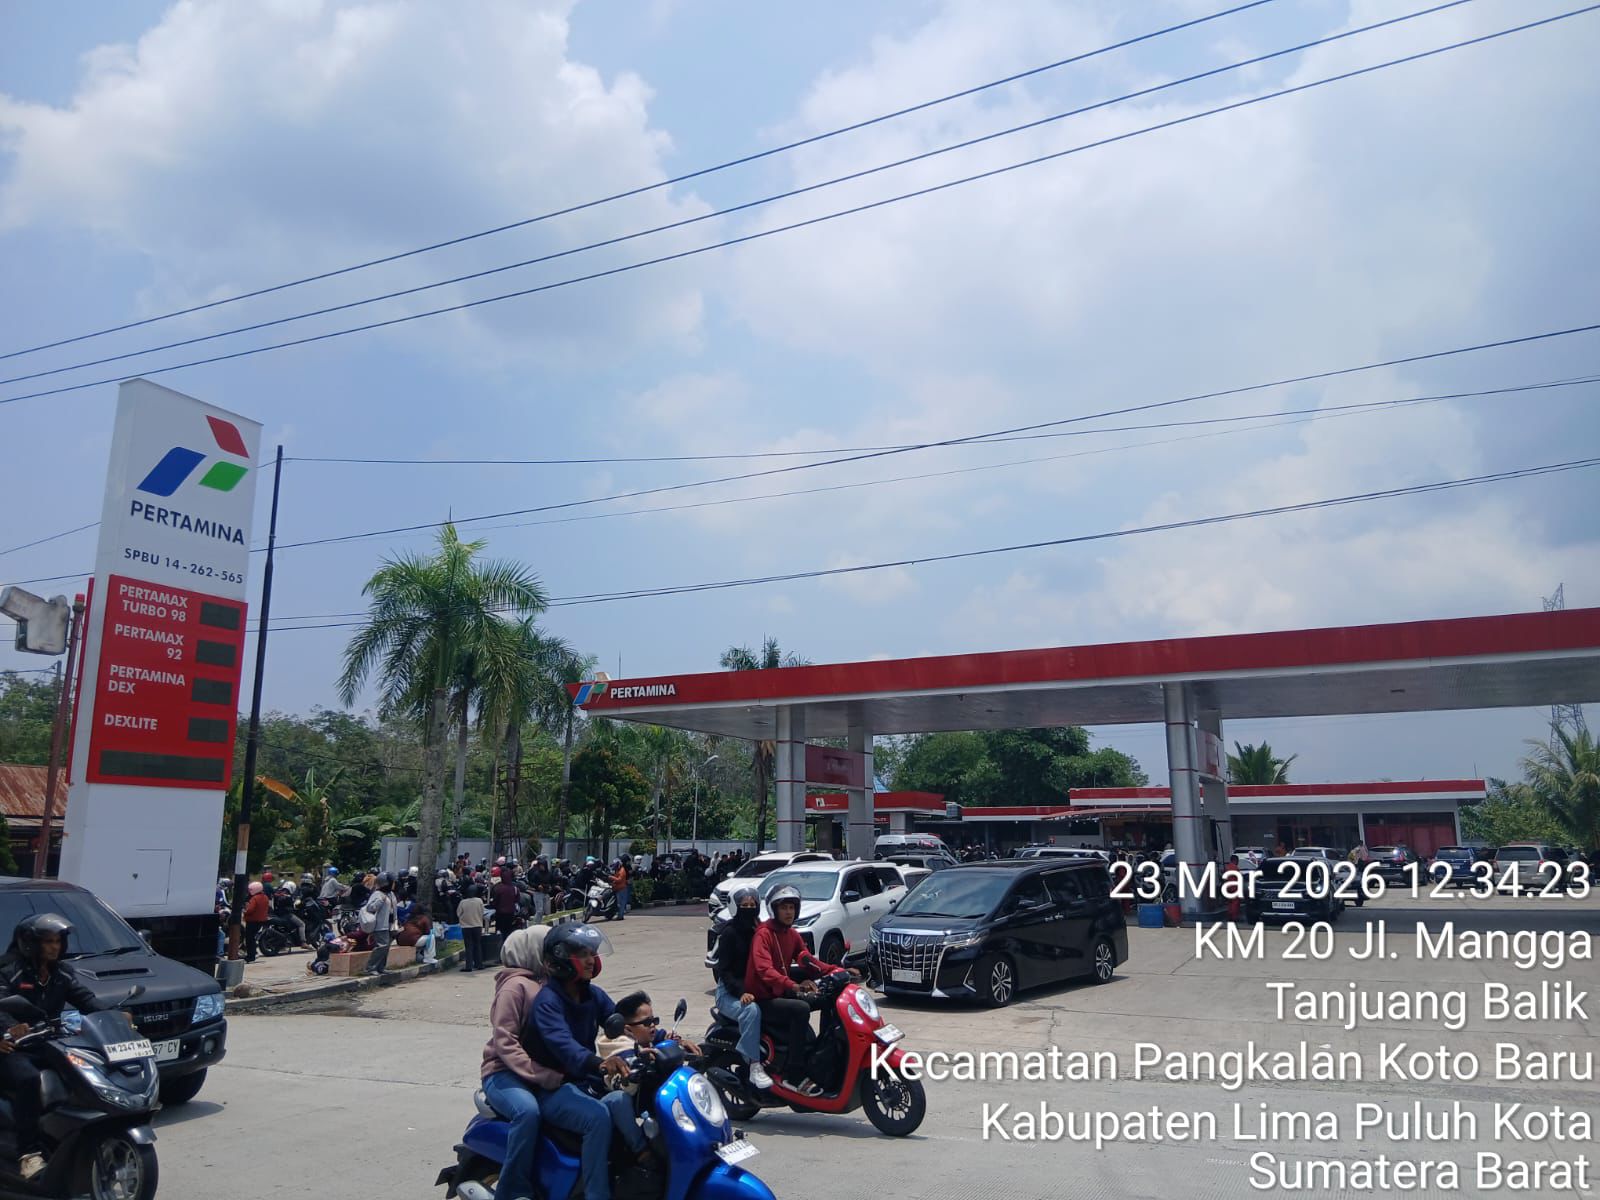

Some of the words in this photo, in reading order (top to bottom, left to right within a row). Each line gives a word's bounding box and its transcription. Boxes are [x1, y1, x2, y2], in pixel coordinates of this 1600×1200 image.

[130, 500, 244, 545] PERTAMINA
[124, 548, 160, 565] SPBU
[119, 584, 188, 608] PERTAMAX
[122, 600, 167, 618] TURBO
[171, 609, 187, 622] 98
[114, 623, 184, 646] PERTAMAX
[167, 648, 183, 661] 92
[110, 664, 185, 686] PERTAMINA
[108, 680, 136, 694] DEX
[610, 684, 676, 699] PERTAMINA
[104, 714, 158, 731] DEXLITE
